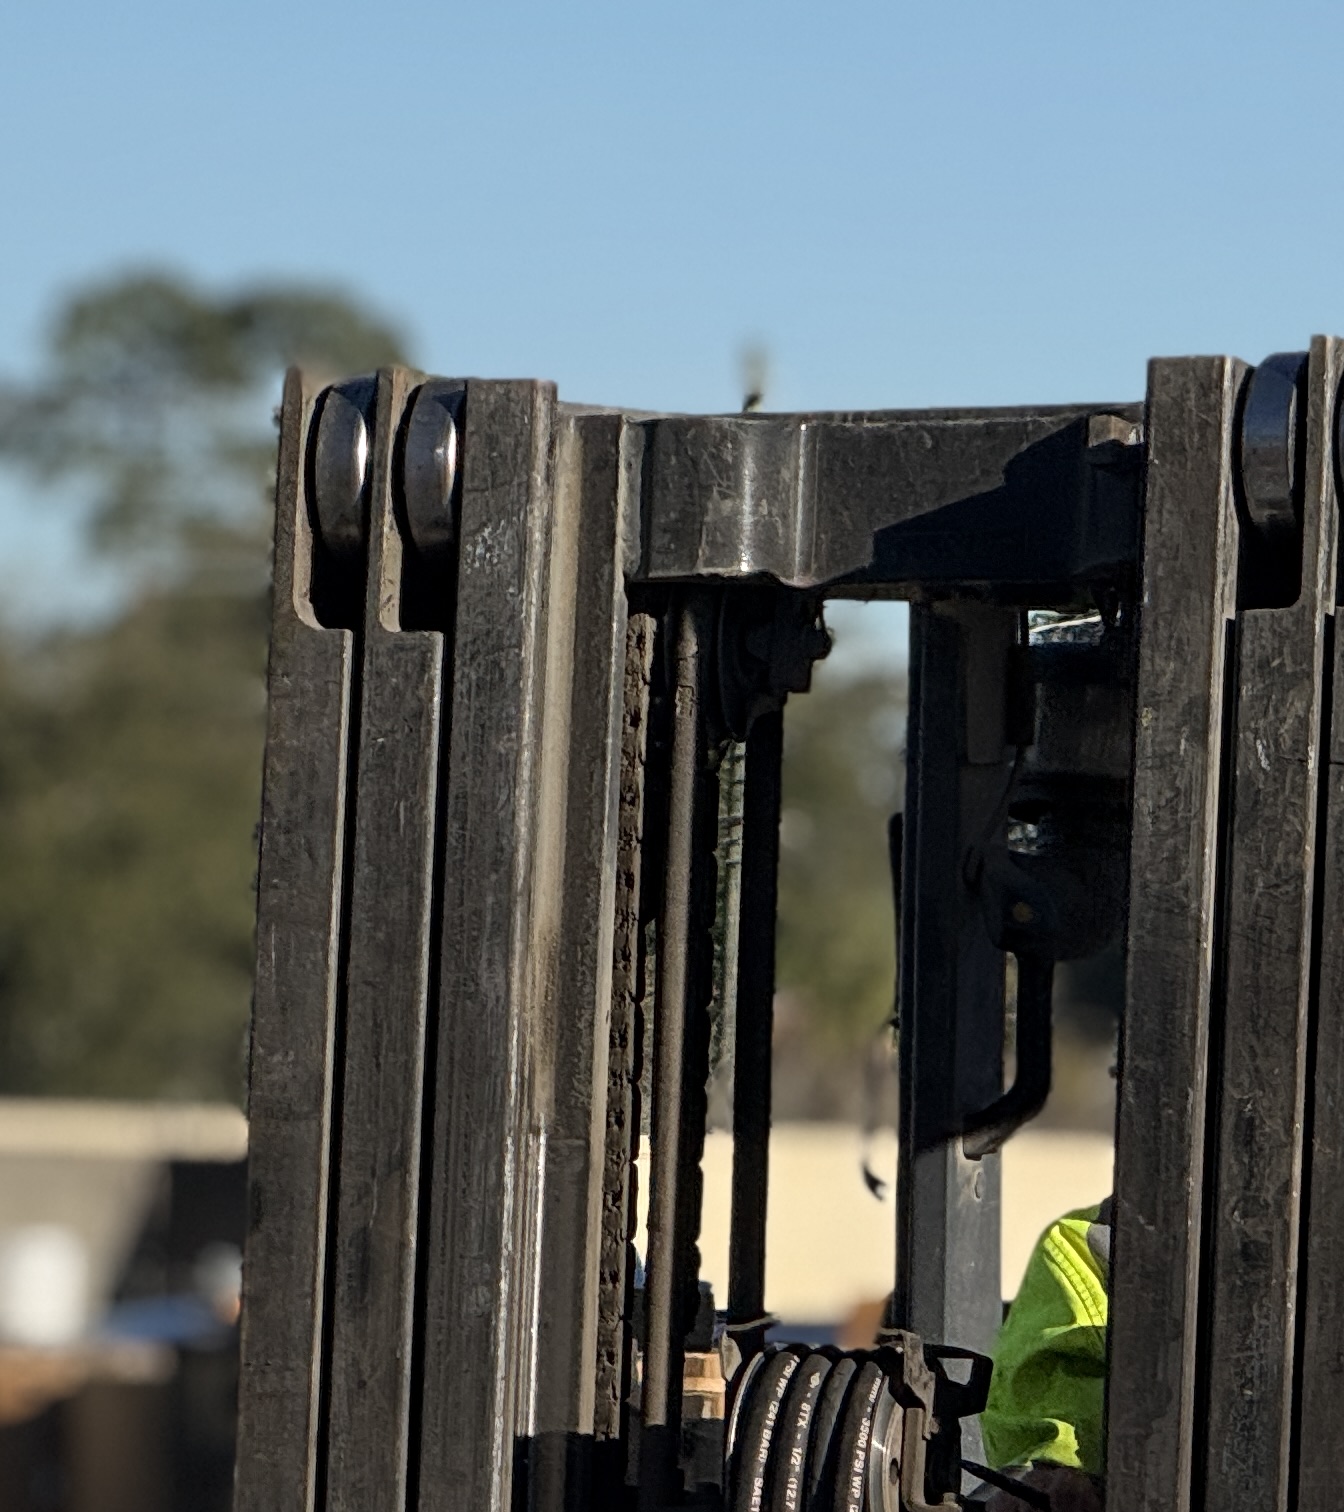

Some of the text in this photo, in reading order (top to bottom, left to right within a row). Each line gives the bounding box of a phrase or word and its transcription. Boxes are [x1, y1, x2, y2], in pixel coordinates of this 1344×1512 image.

[775, 1377, 788, 1398] WP
[797, 1402, 811, 1429] 8TX
[857, 1417, 871, 1448] 3500
[854, 1450, 866, 1472] PSI
[785, 1477, 799, 1508] (12.7
[851, 1476, 863, 1498] WP
